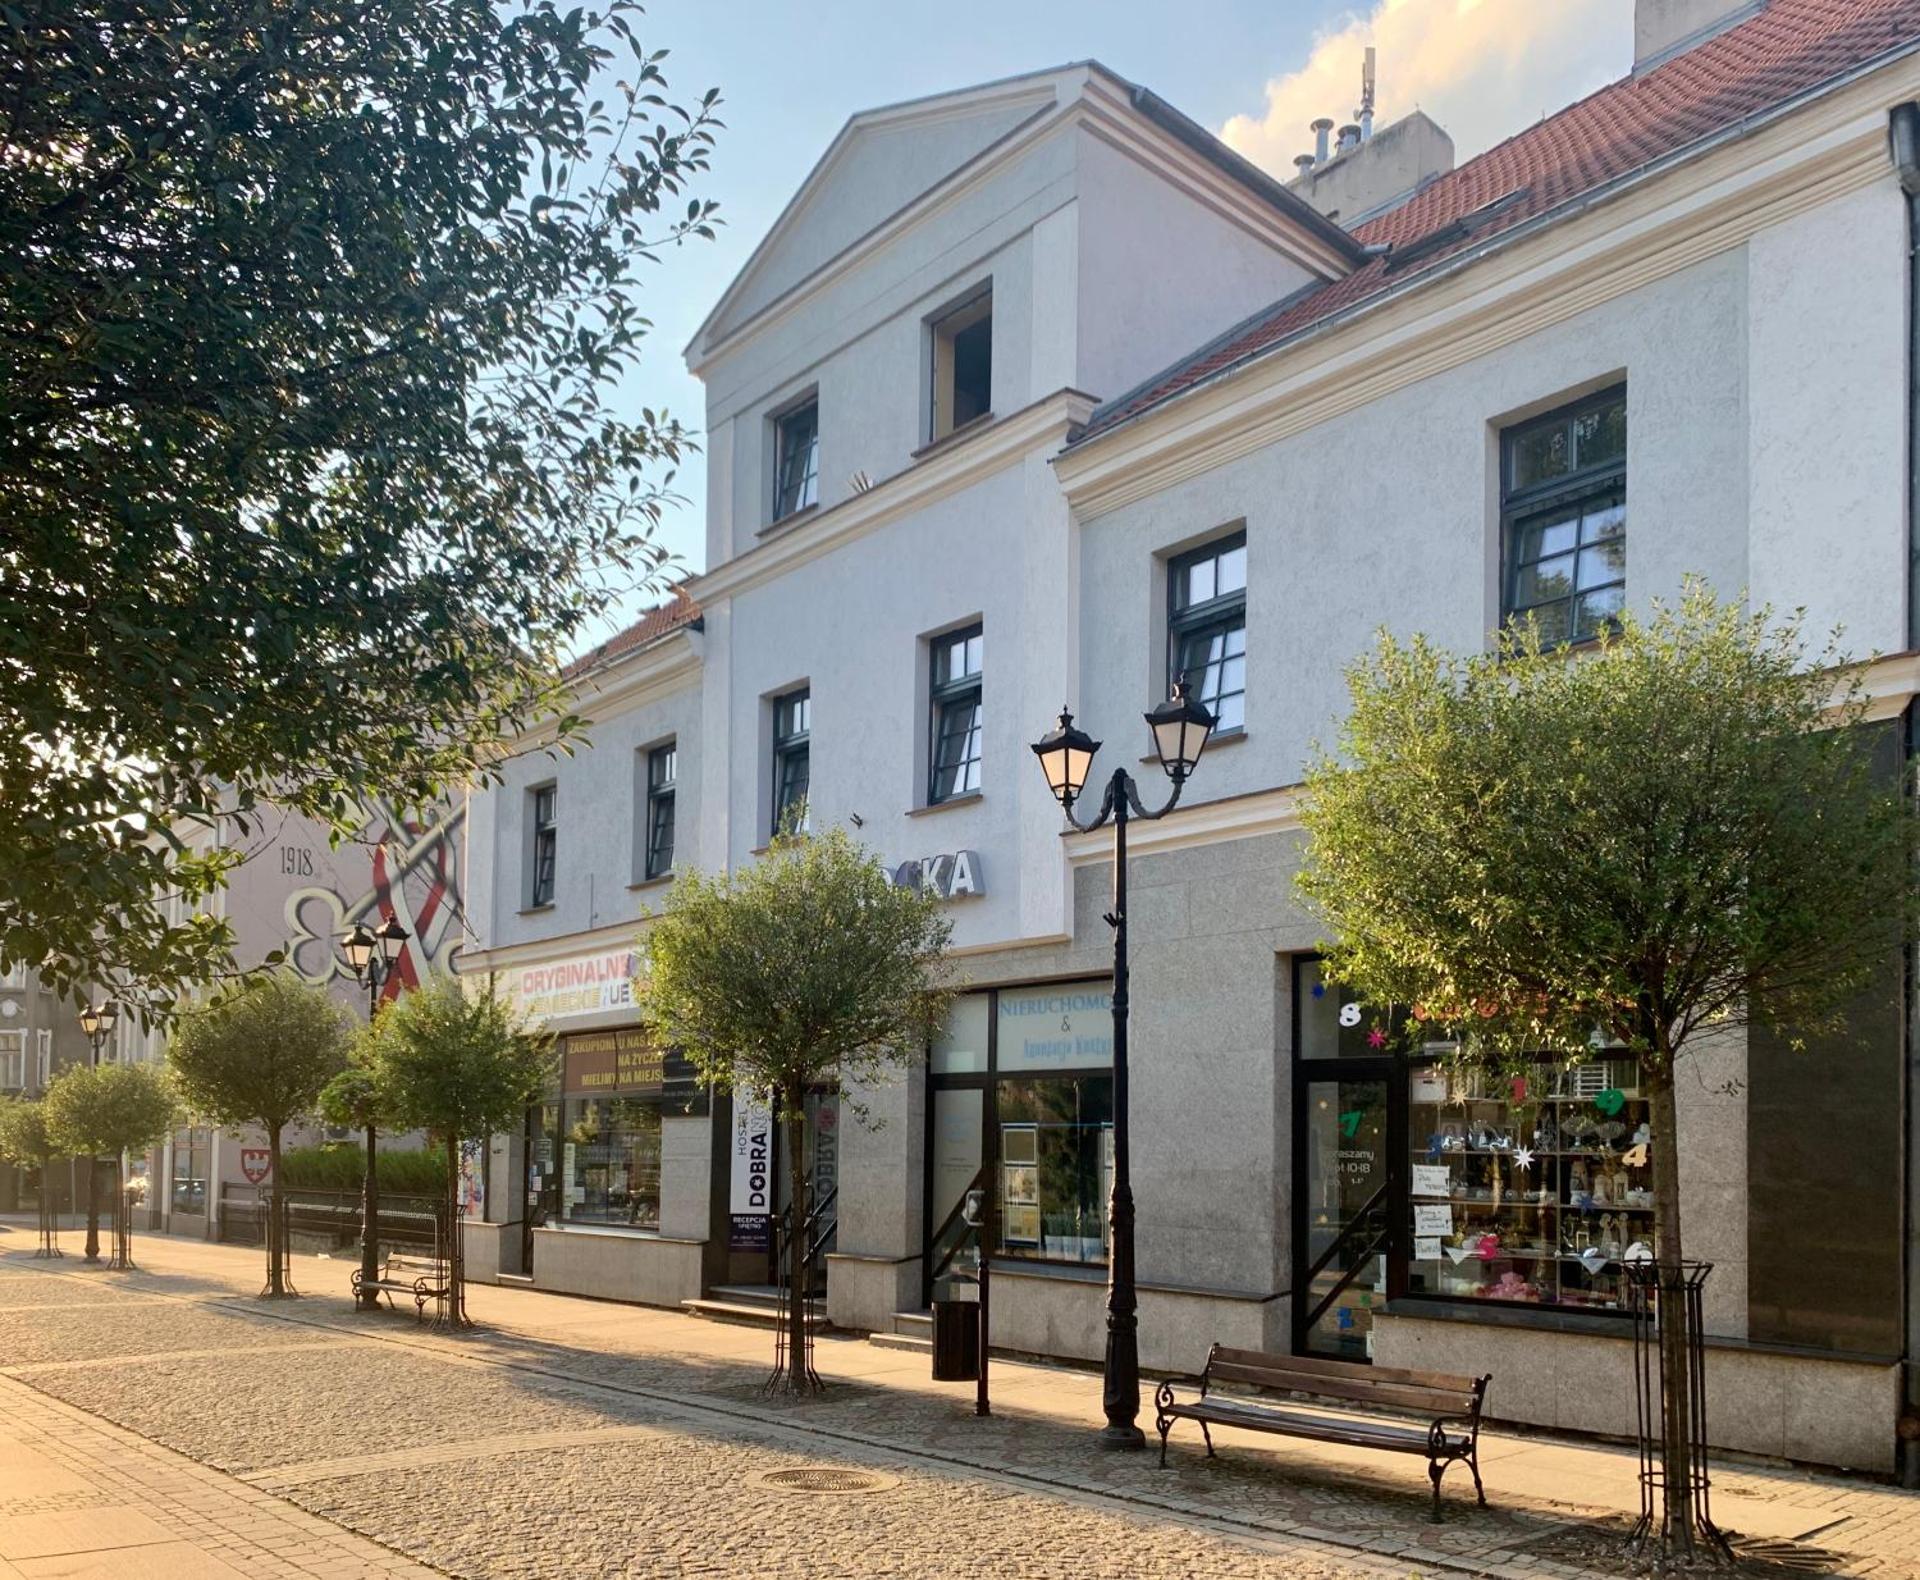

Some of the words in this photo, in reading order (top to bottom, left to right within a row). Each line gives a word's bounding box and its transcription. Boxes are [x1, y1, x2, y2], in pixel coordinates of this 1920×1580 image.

[280, 846, 313, 876] 1918
[1061, 1015, 1072, 1032] &
[1340, 1003, 1361, 1027] 8
[1595, 1088, 1625, 1116] 9
[1338, 1110, 1362, 1137] 7
[1622, 1143, 1648, 1168] 4
